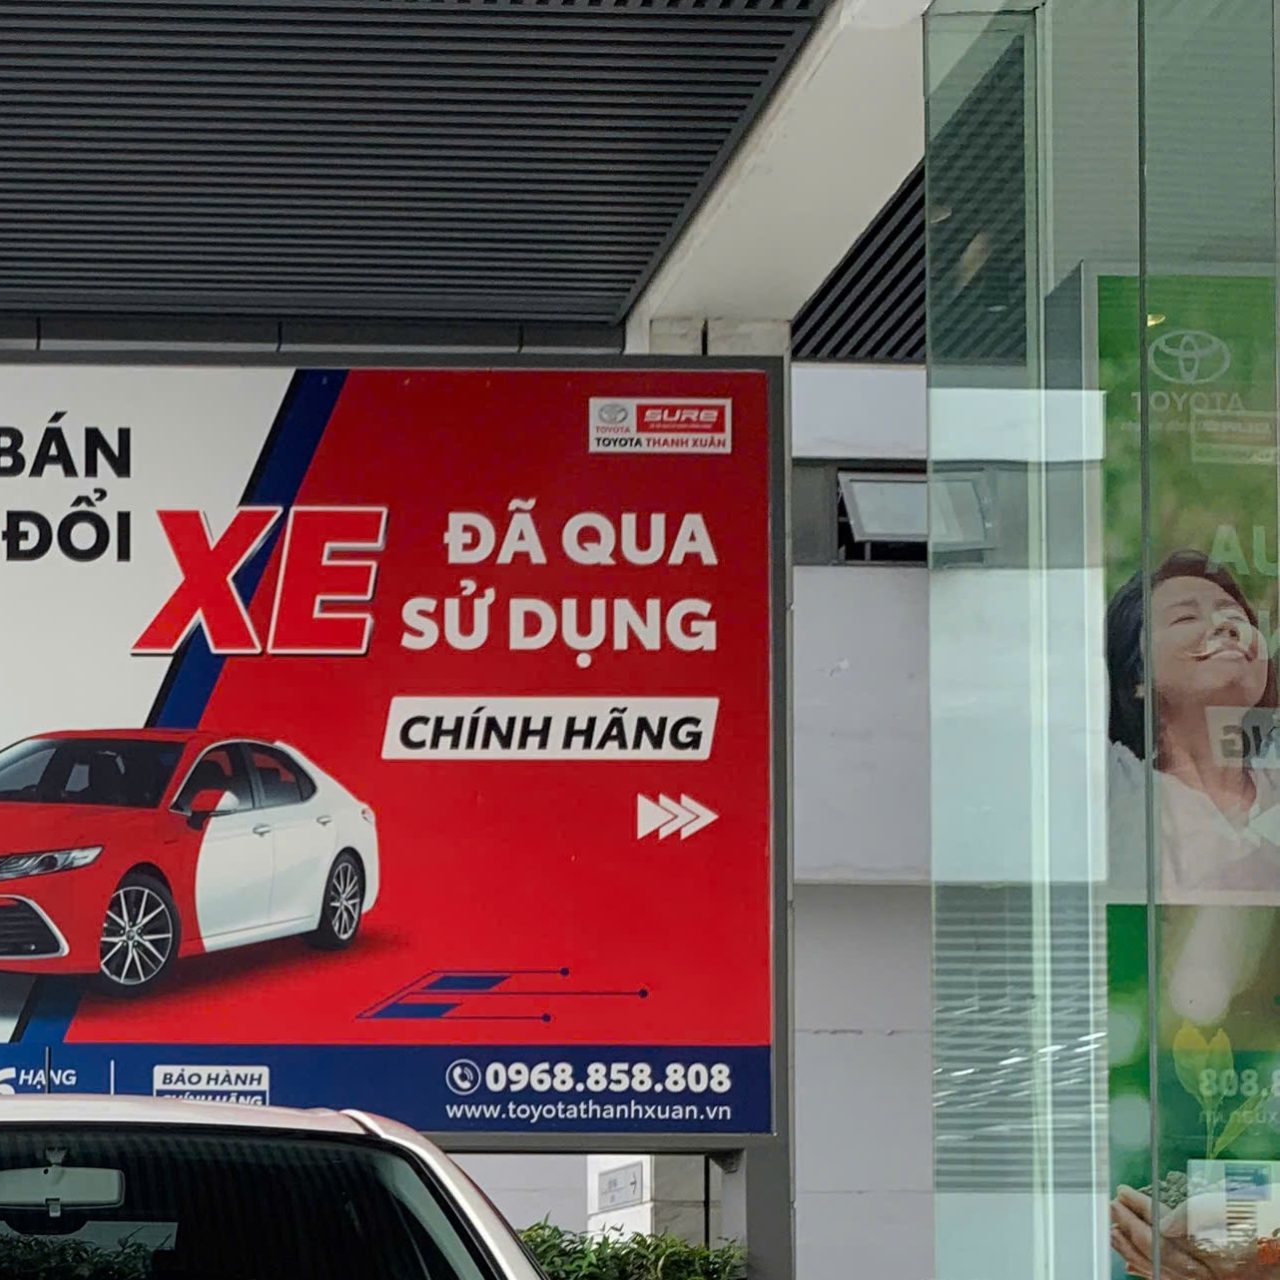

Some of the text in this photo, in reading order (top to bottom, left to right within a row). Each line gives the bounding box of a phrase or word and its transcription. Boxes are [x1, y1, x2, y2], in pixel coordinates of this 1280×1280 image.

[595, 435, 726, 448] TOYOTA THANH XUÂN
[596, 425, 631, 434] TOYOTA
[2, 488, 131, 562] ĐỔI
[444, 497, 718, 566] ĐÃ QUA
[131, 505, 388, 656] XE
[401, 579, 717, 669] SỬ DỤNG
[399, 705, 703, 750] CHÍNH HÃNG
[162, 1068, 263, 1086] BẢO HÀNH
[485, 1062, 732, 1093] 0968.858.808
[446, 1100, 732, 1123] www.toyotathanhxuan.vn
